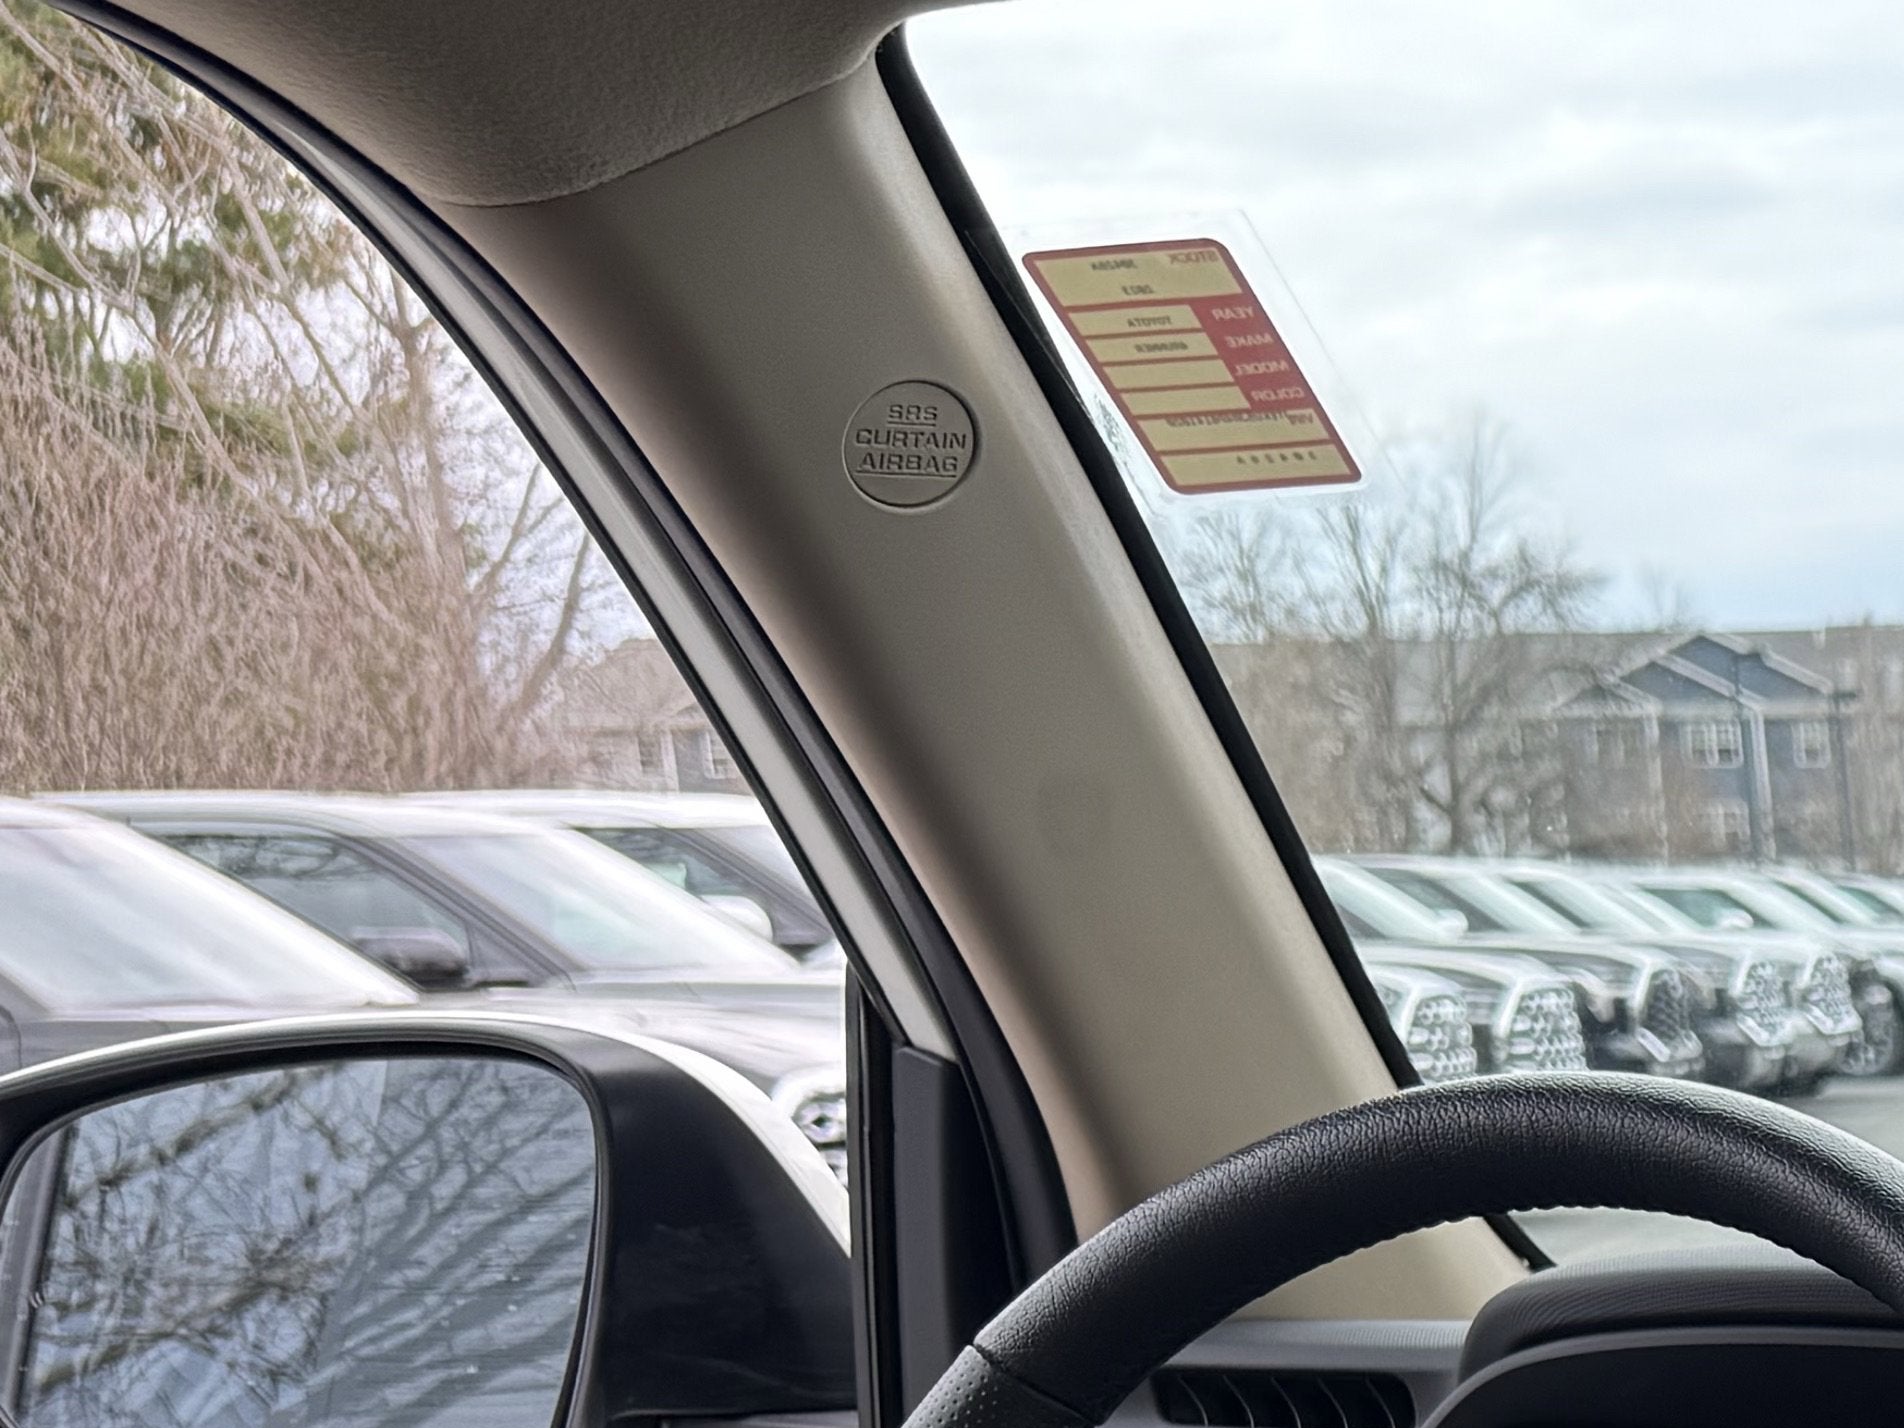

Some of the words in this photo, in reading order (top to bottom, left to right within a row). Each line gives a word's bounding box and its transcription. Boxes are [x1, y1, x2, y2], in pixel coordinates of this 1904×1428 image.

[888, 404, 938, 421] SRS
[855, 428, 967, 450] CURTAIN
[860, 452, 958, 473] AIRBAG
